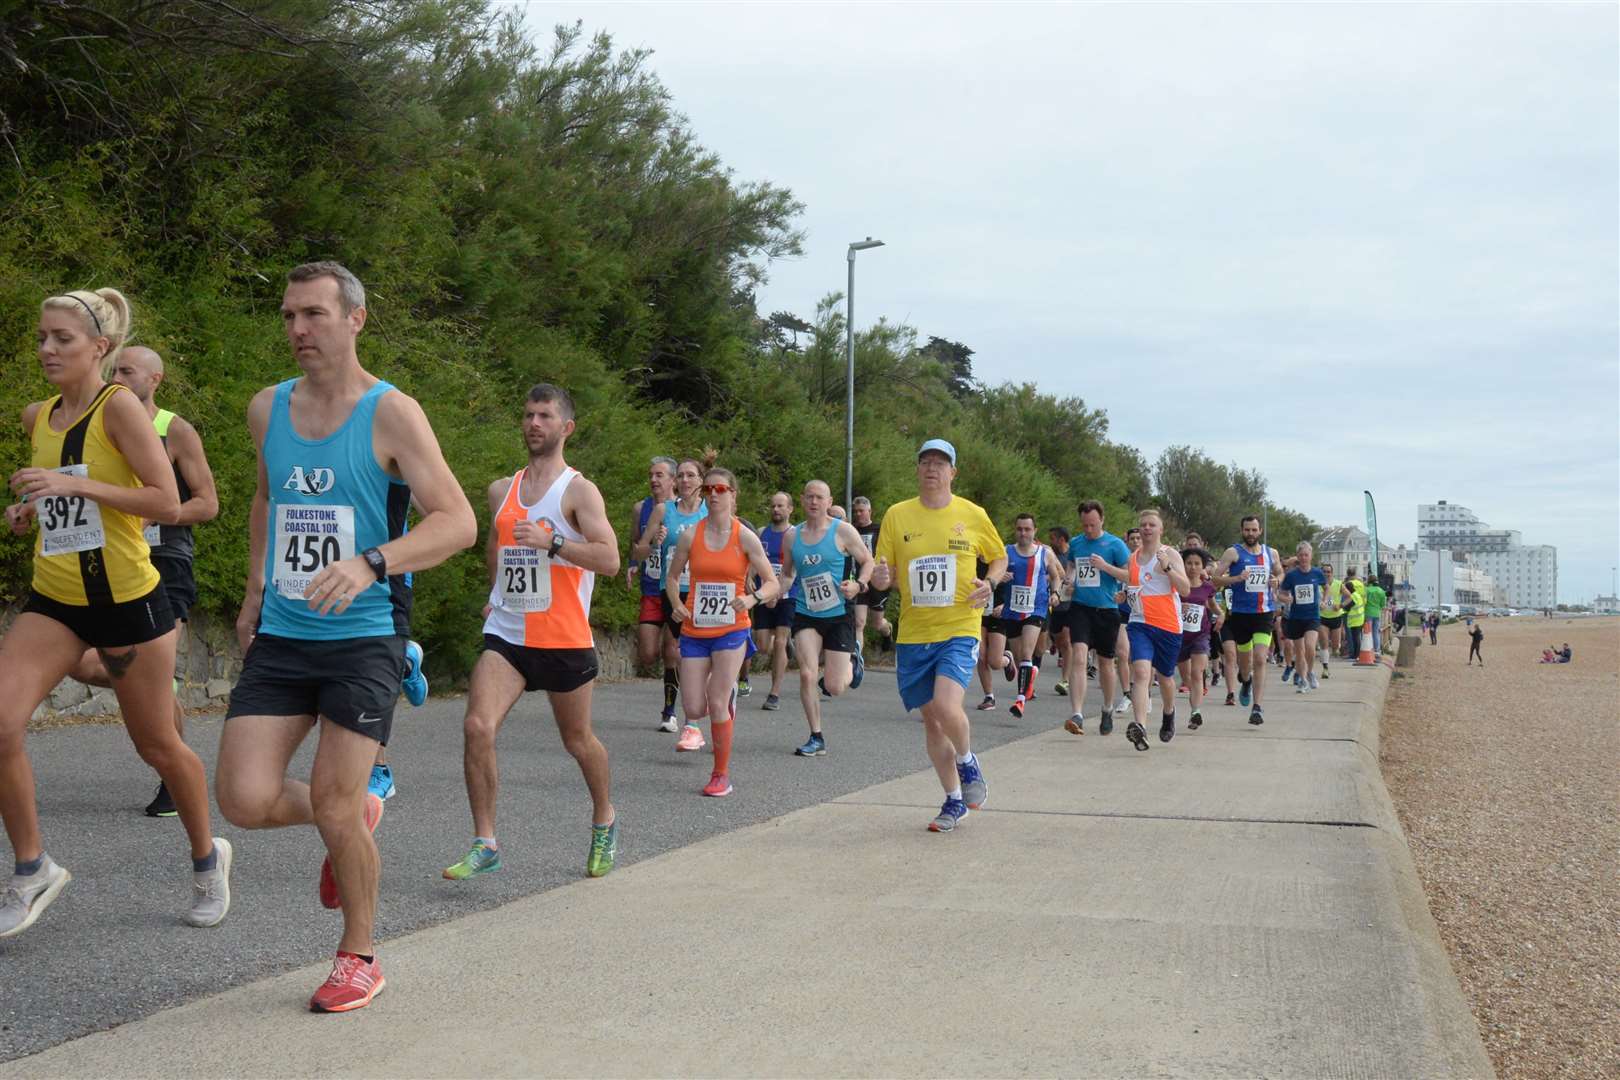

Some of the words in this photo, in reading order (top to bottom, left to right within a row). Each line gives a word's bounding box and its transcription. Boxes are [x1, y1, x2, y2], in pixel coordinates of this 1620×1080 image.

[44, 496, 88, 531] 392
[286, 509, 336, 520] FOLKESTONE
[285, 522, 320, 533] COASTAL
[322, 523, 338, 534] 10K
[285, 535, 341, 572] 450
[505, 566, 538, 593] 231
[1079, 566, 1095, 578] 675
[1250, 574, 1266, 585] 272
[919, 571, 946, 592] 191
[809, 584, 831, 602] 418
[1015, 594, 1029, 605] 121
[700, 597, 728, 615] 292
